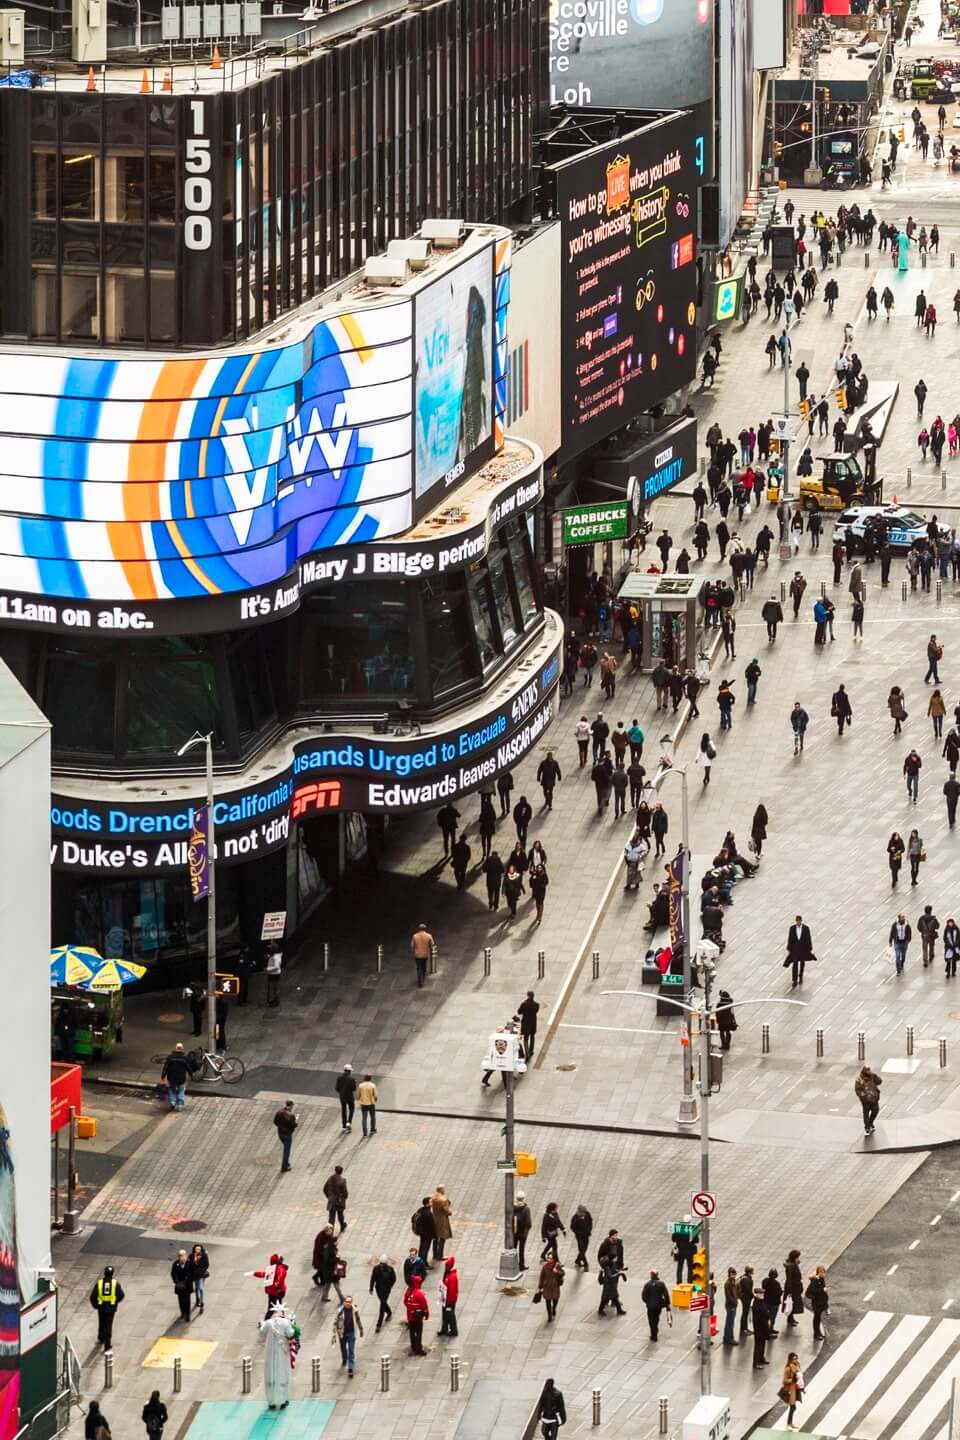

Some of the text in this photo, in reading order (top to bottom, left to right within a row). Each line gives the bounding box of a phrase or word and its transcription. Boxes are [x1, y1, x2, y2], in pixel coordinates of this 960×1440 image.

[551, 82, 591, 106] Loh
[184, 101, 212, 251] 1500
[569, 150, 681, 221] How to go LIVE when you think
[569, 229, 593, 263] you're
[594, 210, 631, 244] witnessing
[644, 458, 683, 500] PROXIMITY
[570, 523, 613, 537] COFFEE
[241, 594, 271, 620] It's
[304, 559, 348, 586] Mary
[352, 553, 366, 574] J
[373, 552, 435, 576] Blige
[62, 607, 91, 627] on
[97, 607, 154, 629] abc.
[51, 808, 101, 831] oods
[213, 782, 288, 825] California
[293, 744, 364, 774] usands
[369, 748, 436, 775] Urged
[441, 742, 455, 761] to
[459, 715, 507, 755] Evacuate
[369, 775, 457, 806] Edwards
[459, 755, 496, 786] leaves
[497, 727, 531, 769] NASCAR
[62, 841, 148, 868] Duke's
[224, 830, 258, 857] not
